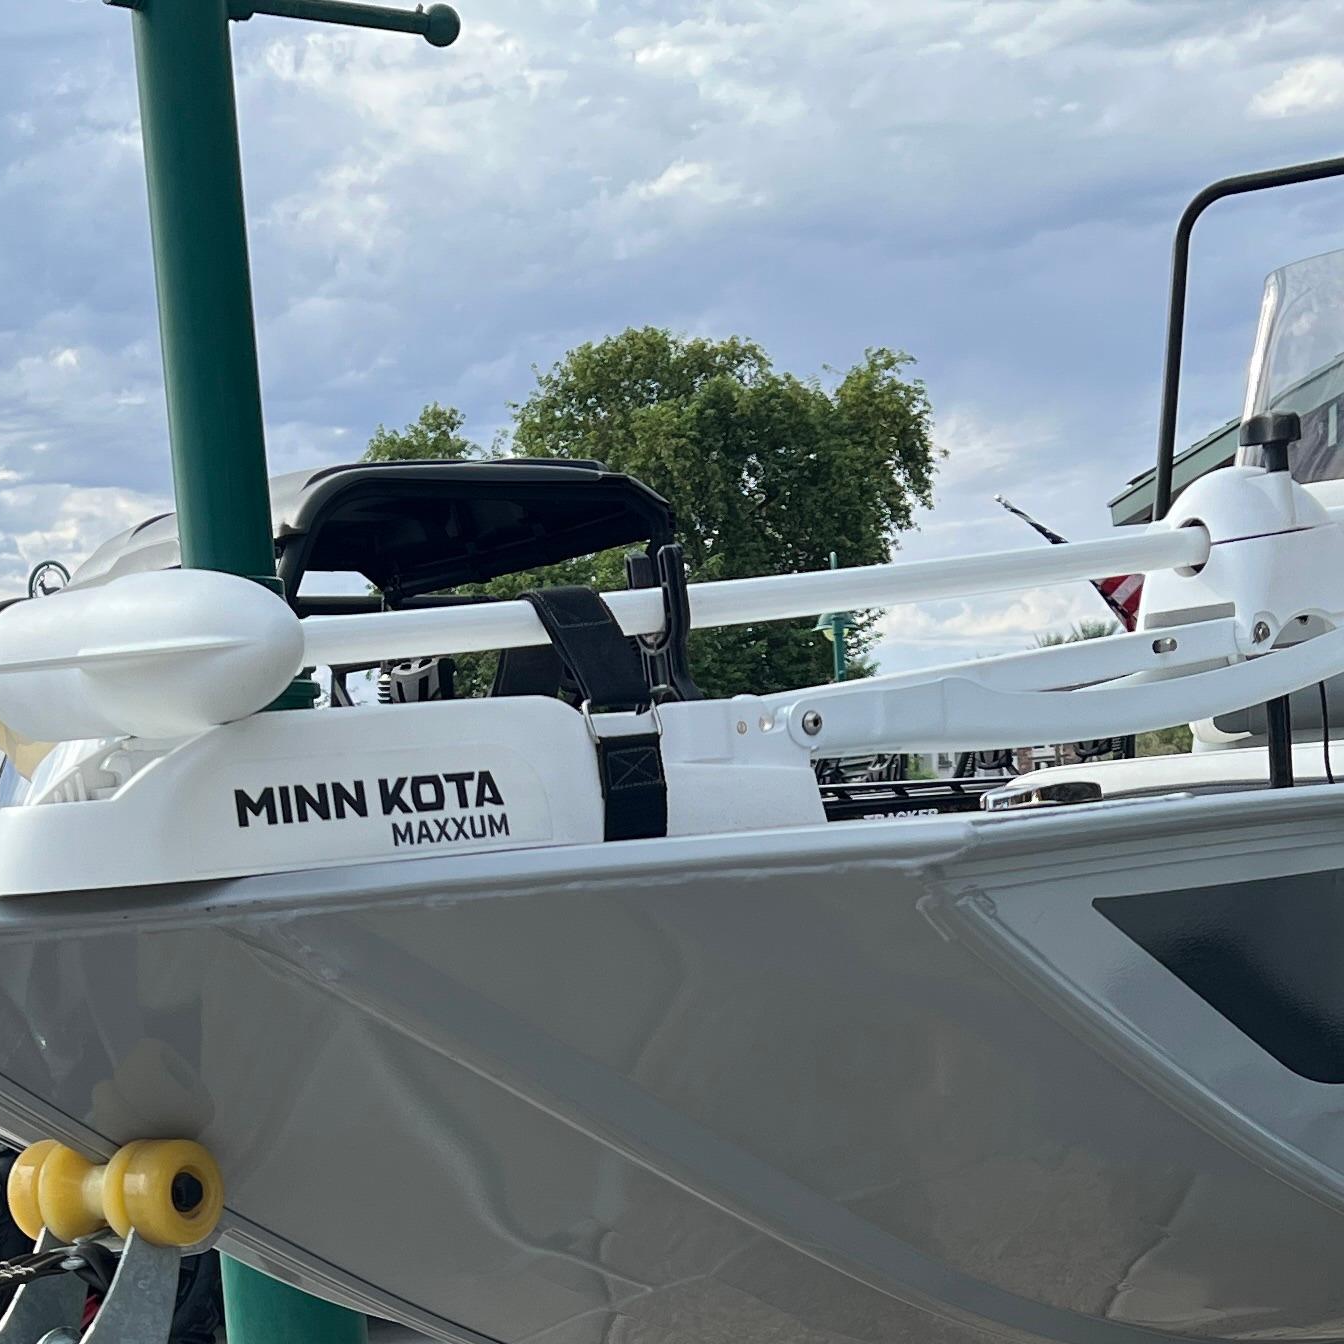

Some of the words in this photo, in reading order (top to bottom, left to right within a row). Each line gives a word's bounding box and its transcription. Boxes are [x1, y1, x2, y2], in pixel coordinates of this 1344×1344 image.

[234, 780, 368, 828] MINN
[378, 770, 505, 816] KOTA
[391, 812, 510, 847] MAXXUM
